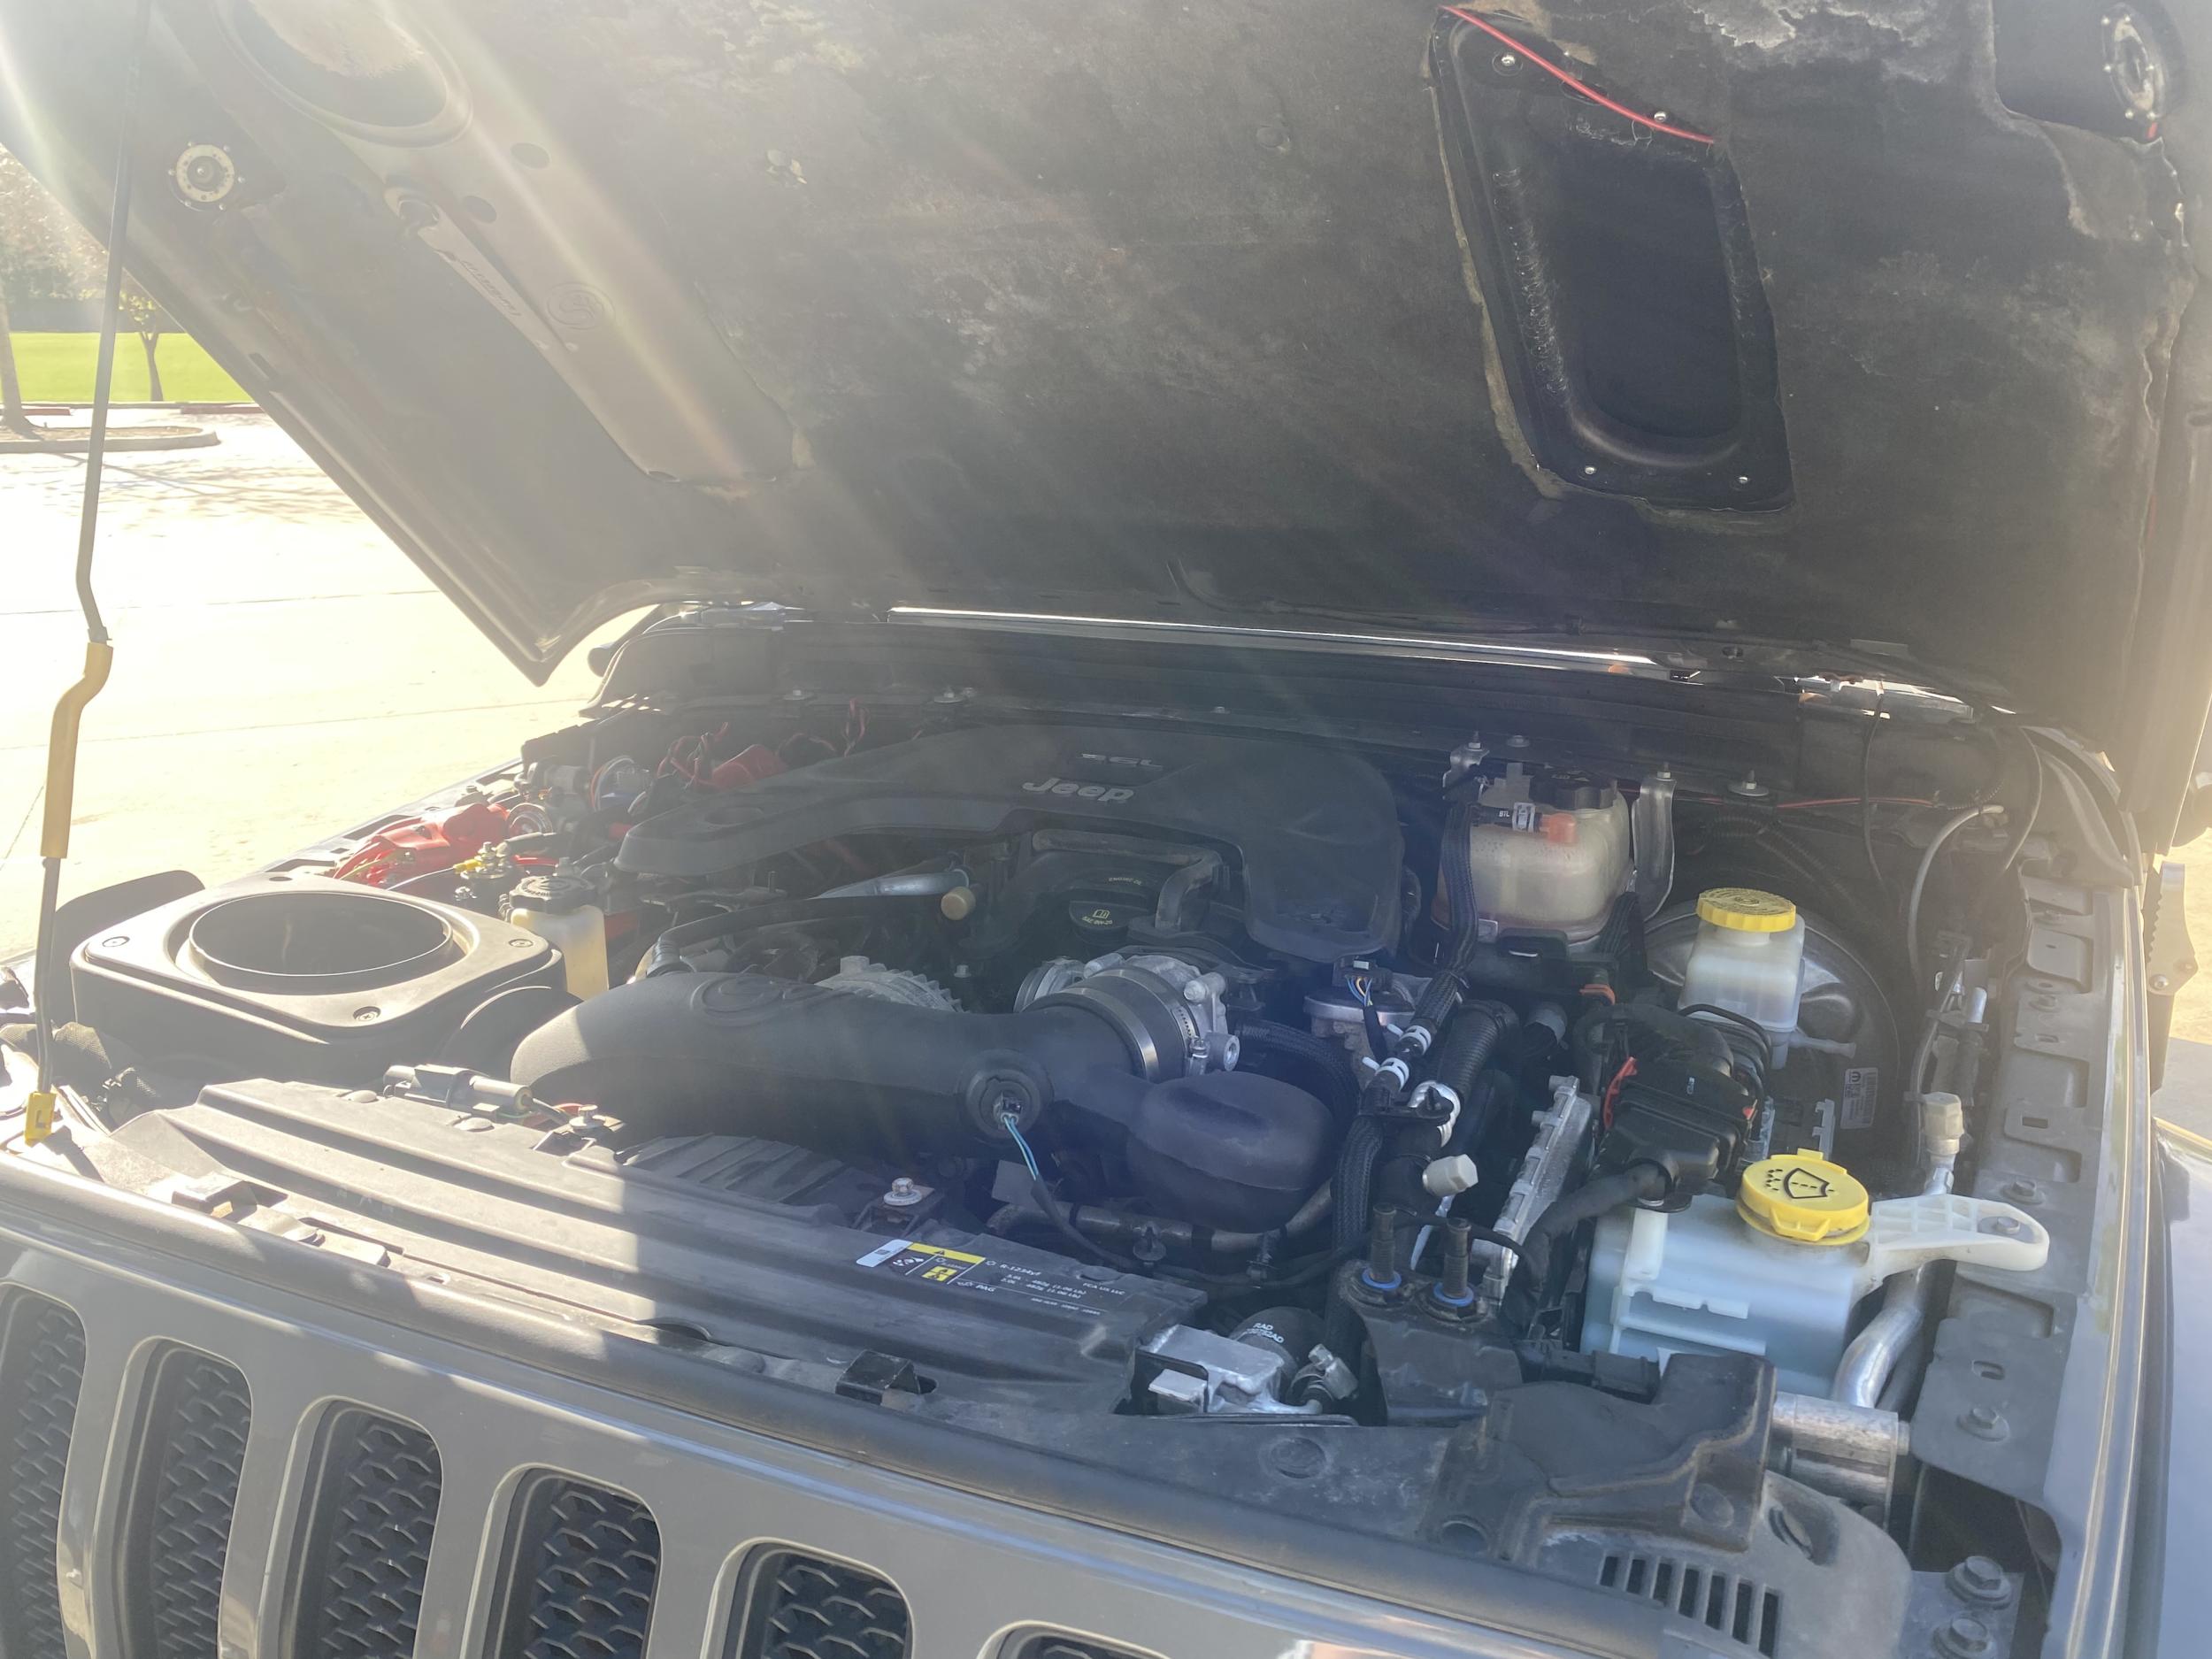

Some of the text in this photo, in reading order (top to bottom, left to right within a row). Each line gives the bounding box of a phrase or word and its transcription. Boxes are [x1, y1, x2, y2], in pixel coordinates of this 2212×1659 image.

[1021, 777, 1134, 803] Jeep
[975, 1284, 996, 1293] PAG
[1253, 1322, 1274, 1331] RAD
